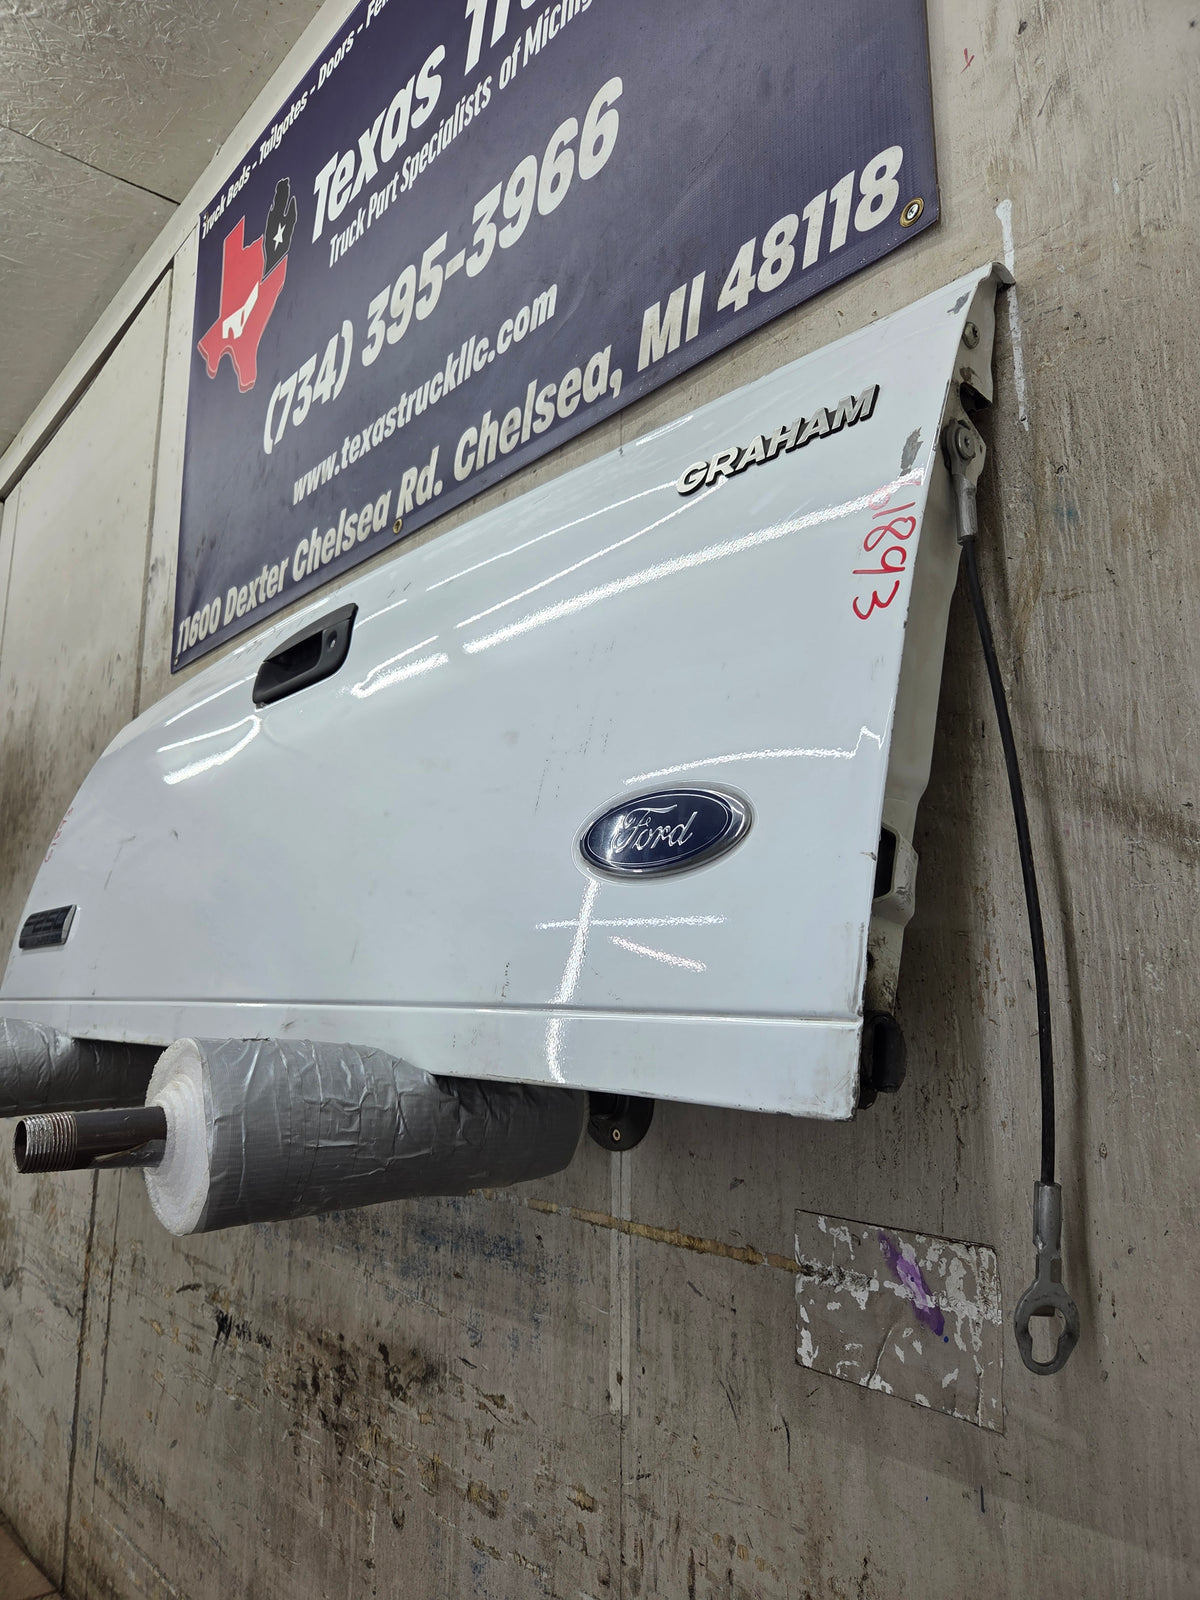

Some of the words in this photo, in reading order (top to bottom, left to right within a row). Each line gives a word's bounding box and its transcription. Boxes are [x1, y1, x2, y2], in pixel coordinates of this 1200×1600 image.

[226, 165, 251, 207] Beds
[259, 90, 309, 165] Tailgates
[317, 30, 355, 90] Doors
[365, 0, 389, 29] Fe
[311, 44, 446, 244] Texas
[463, 0, 537, 77] Tr
[329, 207, 366, 268] Truck
[366, 171, 400, 230] Part
[400, 75, 492, 193] Specialists
[498, 36, 522, 90] of
[263, 319, 354, 455] (734)
[361, 76, 624, 367] 395-3966
[176, 596, 222, 656] 11600
[223, 556, 289, 627] Dexter
[292, 489, 392, 582] Chelsea
[397, 445, 443, 518] Rd.
[453, 344, 624, 482] Chelsea,
[637, 270, 706, 373] MI
[717, 145, 904, 314] 48118
[292, 284, 559, 506] www.texastruckllc.com
[676, 384, 881, 496] GRAHAM
[610, 803, 699, 854] Ford
